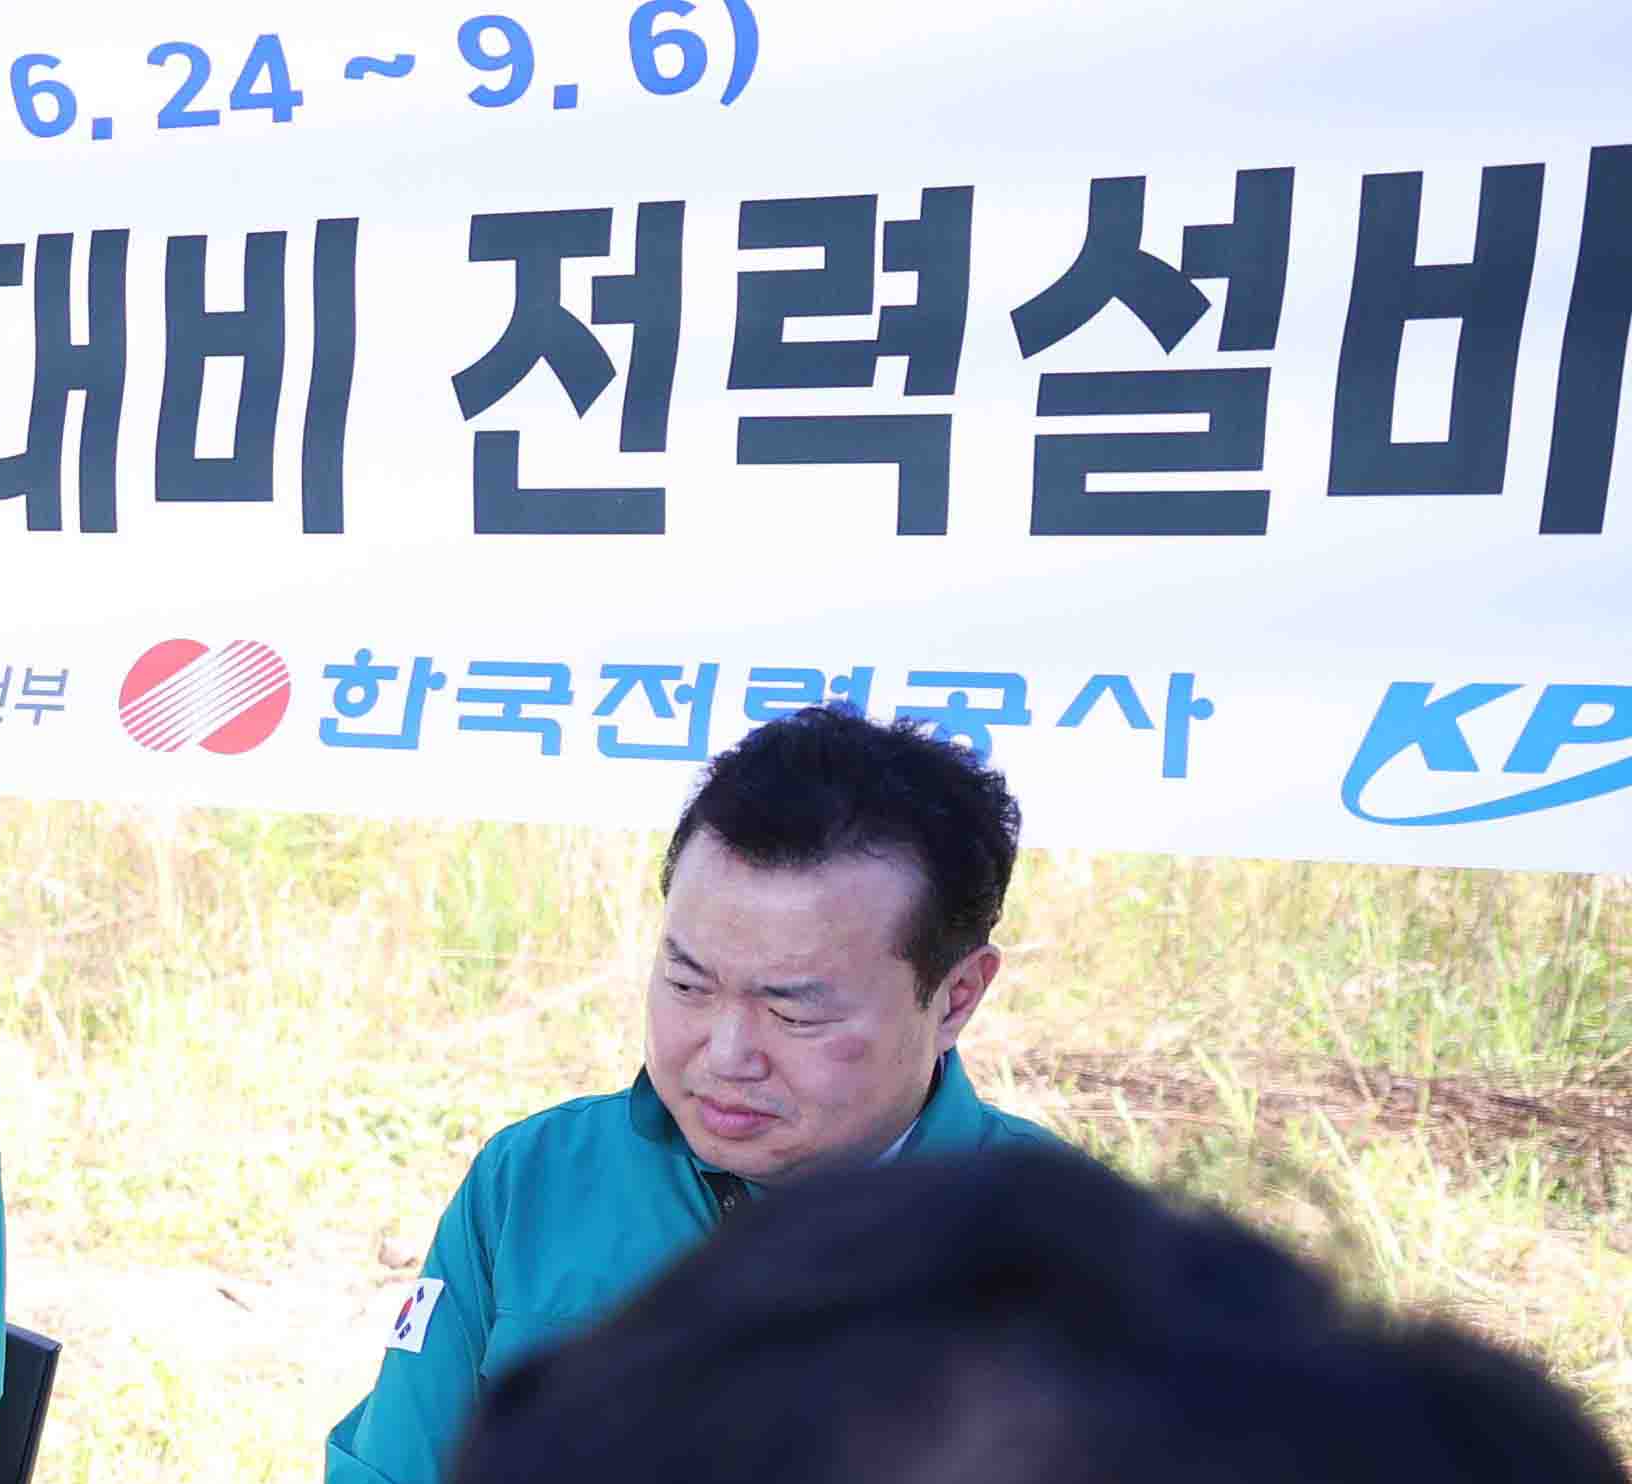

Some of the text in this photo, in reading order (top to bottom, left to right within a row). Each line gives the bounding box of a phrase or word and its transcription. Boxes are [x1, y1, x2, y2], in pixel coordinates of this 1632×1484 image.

[10, 54, 114, 142] 6.
[147, 34, 305, 131] 24
[458, 15, 580, 112] 9.
[629, 0, 761, 108] 6)
[452, 144, 1632, 538] 전력설비
